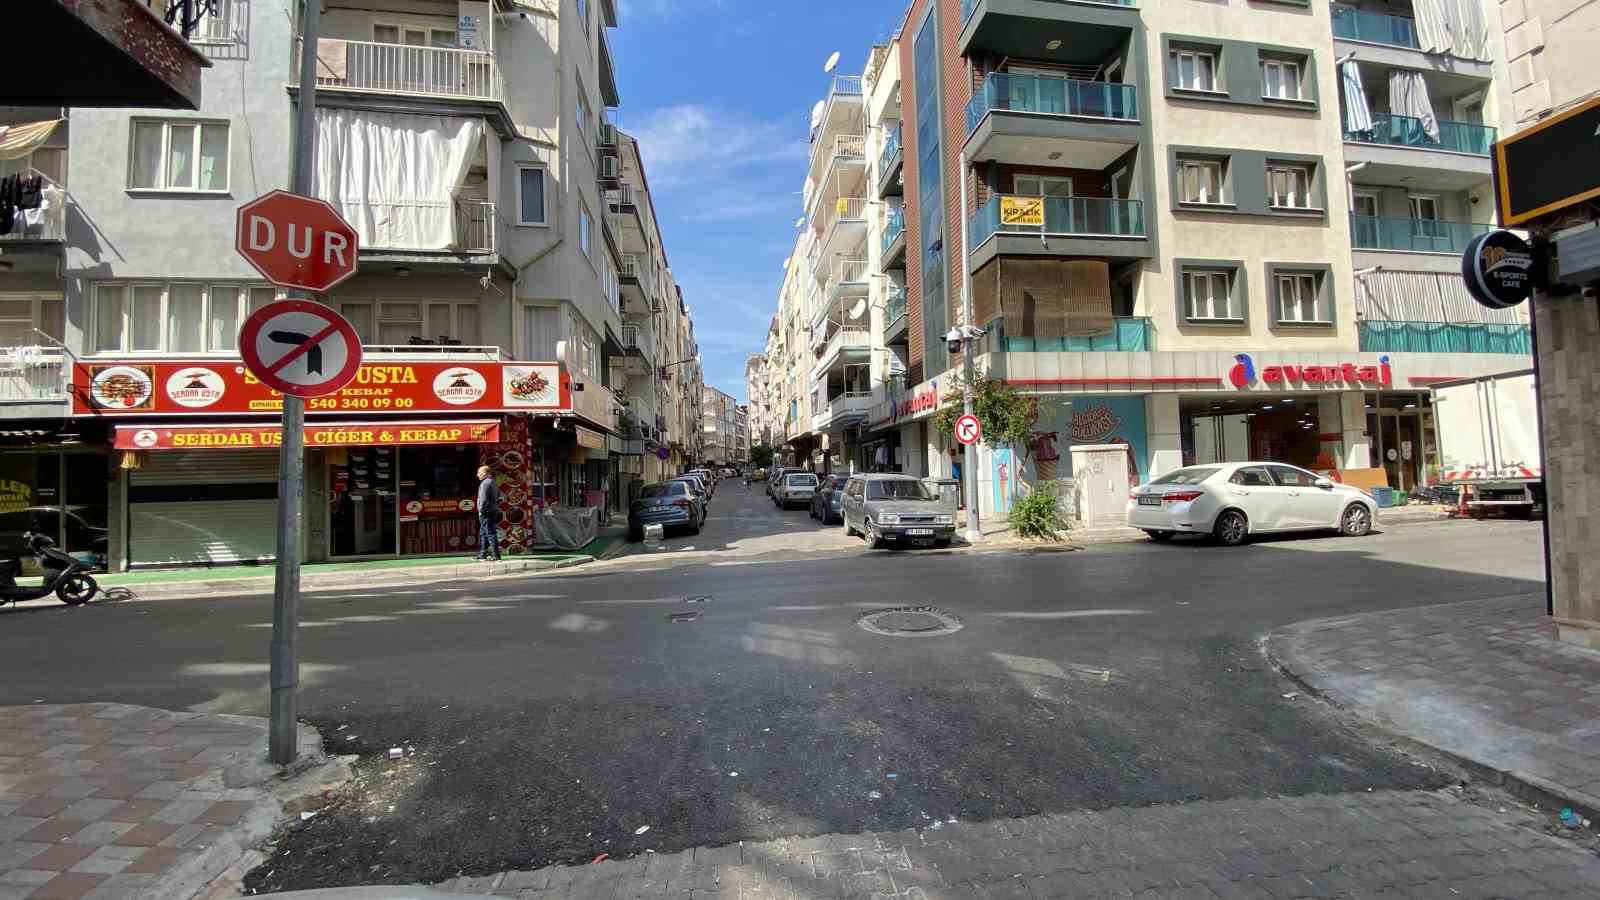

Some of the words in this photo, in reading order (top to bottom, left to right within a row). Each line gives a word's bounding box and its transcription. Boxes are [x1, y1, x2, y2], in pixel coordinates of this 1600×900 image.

[250, 215, 348, 267] DUR
[356, 366, 418, 385] USTA
[1262, 354, 1393, 386] avantaj
[342, 388, 393, 396] KEBAP
[309, 398, 337, 409] 540
[342, 398, 369, 408] 340
[373, 398, 391, 408] 09
[395, 397, 414, 408] 00
[173, 432, 253, 446] SERDAR
[313, 428, 374, 444] CİĞER
[379, 431, 394, 443] &
[400, 429, 463, 442] KEBAP
